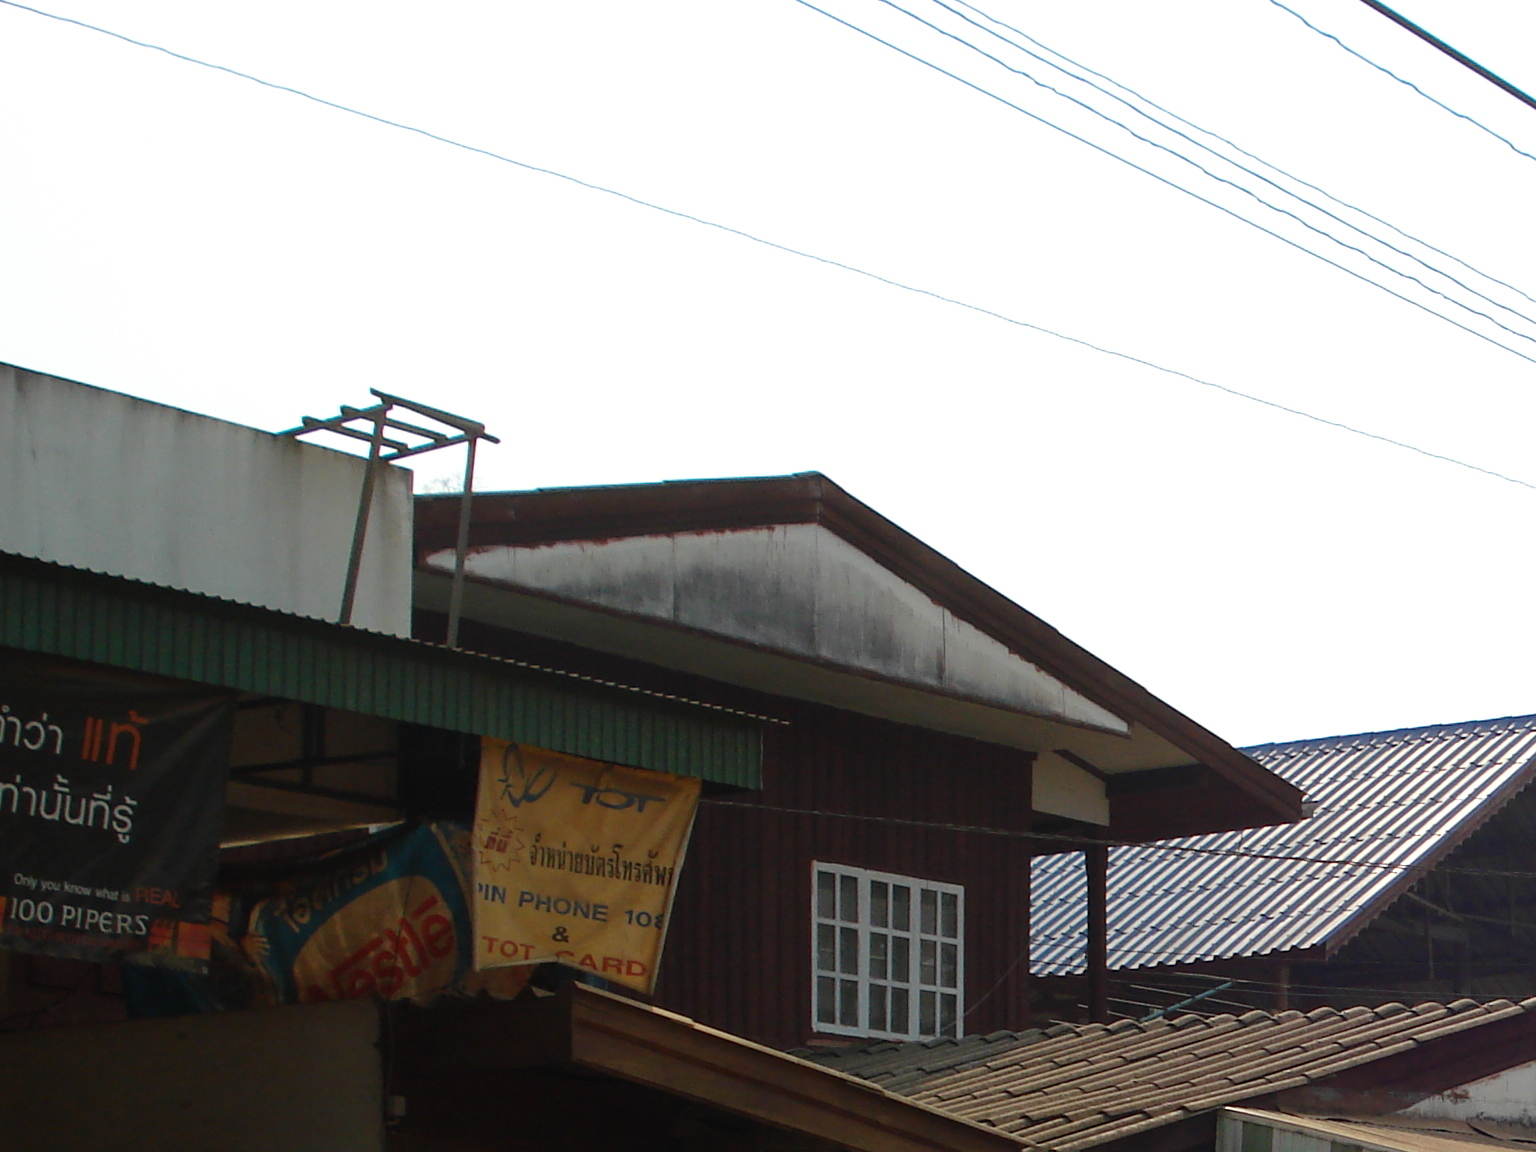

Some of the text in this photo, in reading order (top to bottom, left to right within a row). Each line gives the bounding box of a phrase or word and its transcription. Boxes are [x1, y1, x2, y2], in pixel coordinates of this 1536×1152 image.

[0, 704, 149, 770] ำว่า แท้
[569, 780, 664, 813] TOT
[14, 873, 37, 890] Only
[41, 881, 60, 893] you
[63, 881, 92, 897] know
[95, 888, 119, 902] what
[134, 886, 181, 908] REAL
[518, 891, 609, 922] PHONE
[10, 897, 149, 936] 100 PIPERS
[482, 936, 536, 961] TOT
[552, 926, 569, 943] &
